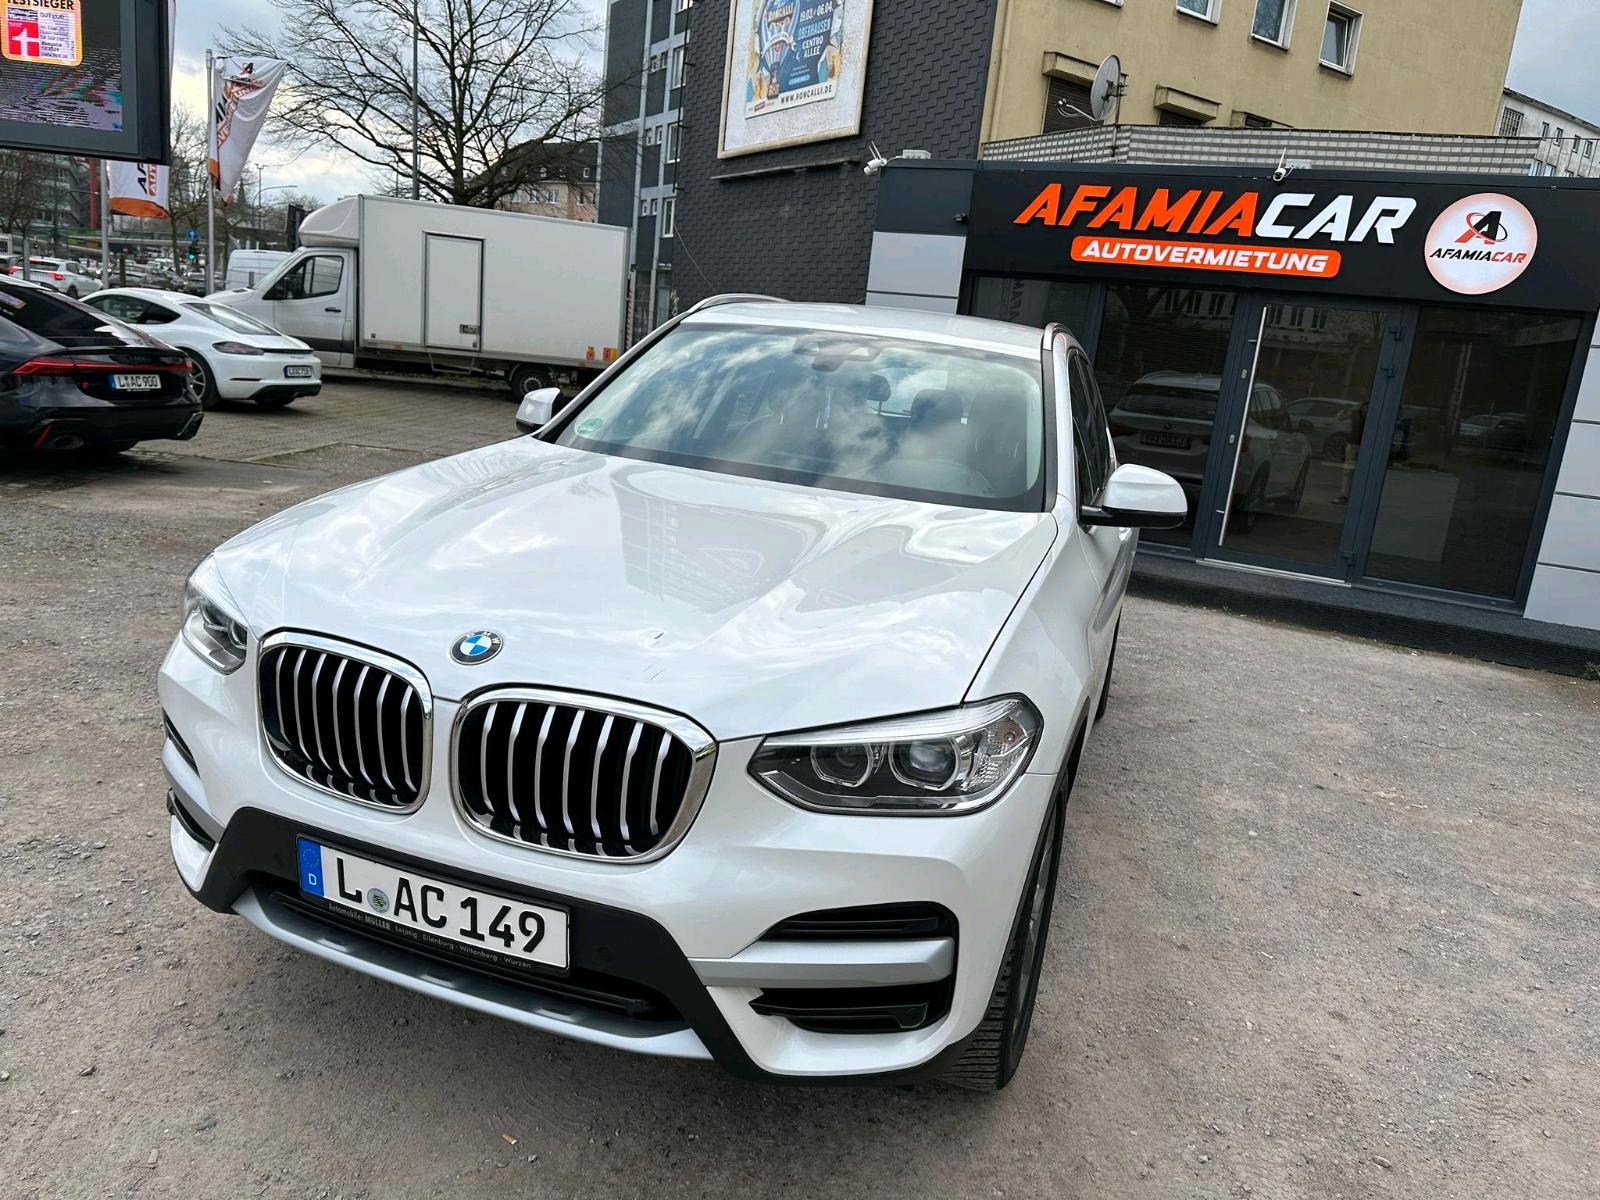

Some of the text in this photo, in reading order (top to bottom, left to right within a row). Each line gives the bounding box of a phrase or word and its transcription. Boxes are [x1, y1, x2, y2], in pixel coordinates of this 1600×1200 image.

[802, 36, 824, 50] CENTRO
[804, 46, 821, 58] ALLEE
[780, 84, 832, 105] WWW.RONCALLI.DE
[1013, 183, 1417, 244] AFAMIACAR
[1081, 239, 1329, 273] AUTOVERMIETUNG
[1429, 247, 1528, 264] AFAMIACAR
[308, 872, 317, 886] D
[336, 857, 546, 953] L AC 149
[422, 934, 454, 950] Eilenburg
[504, 956, 532, 969] Wurzen
